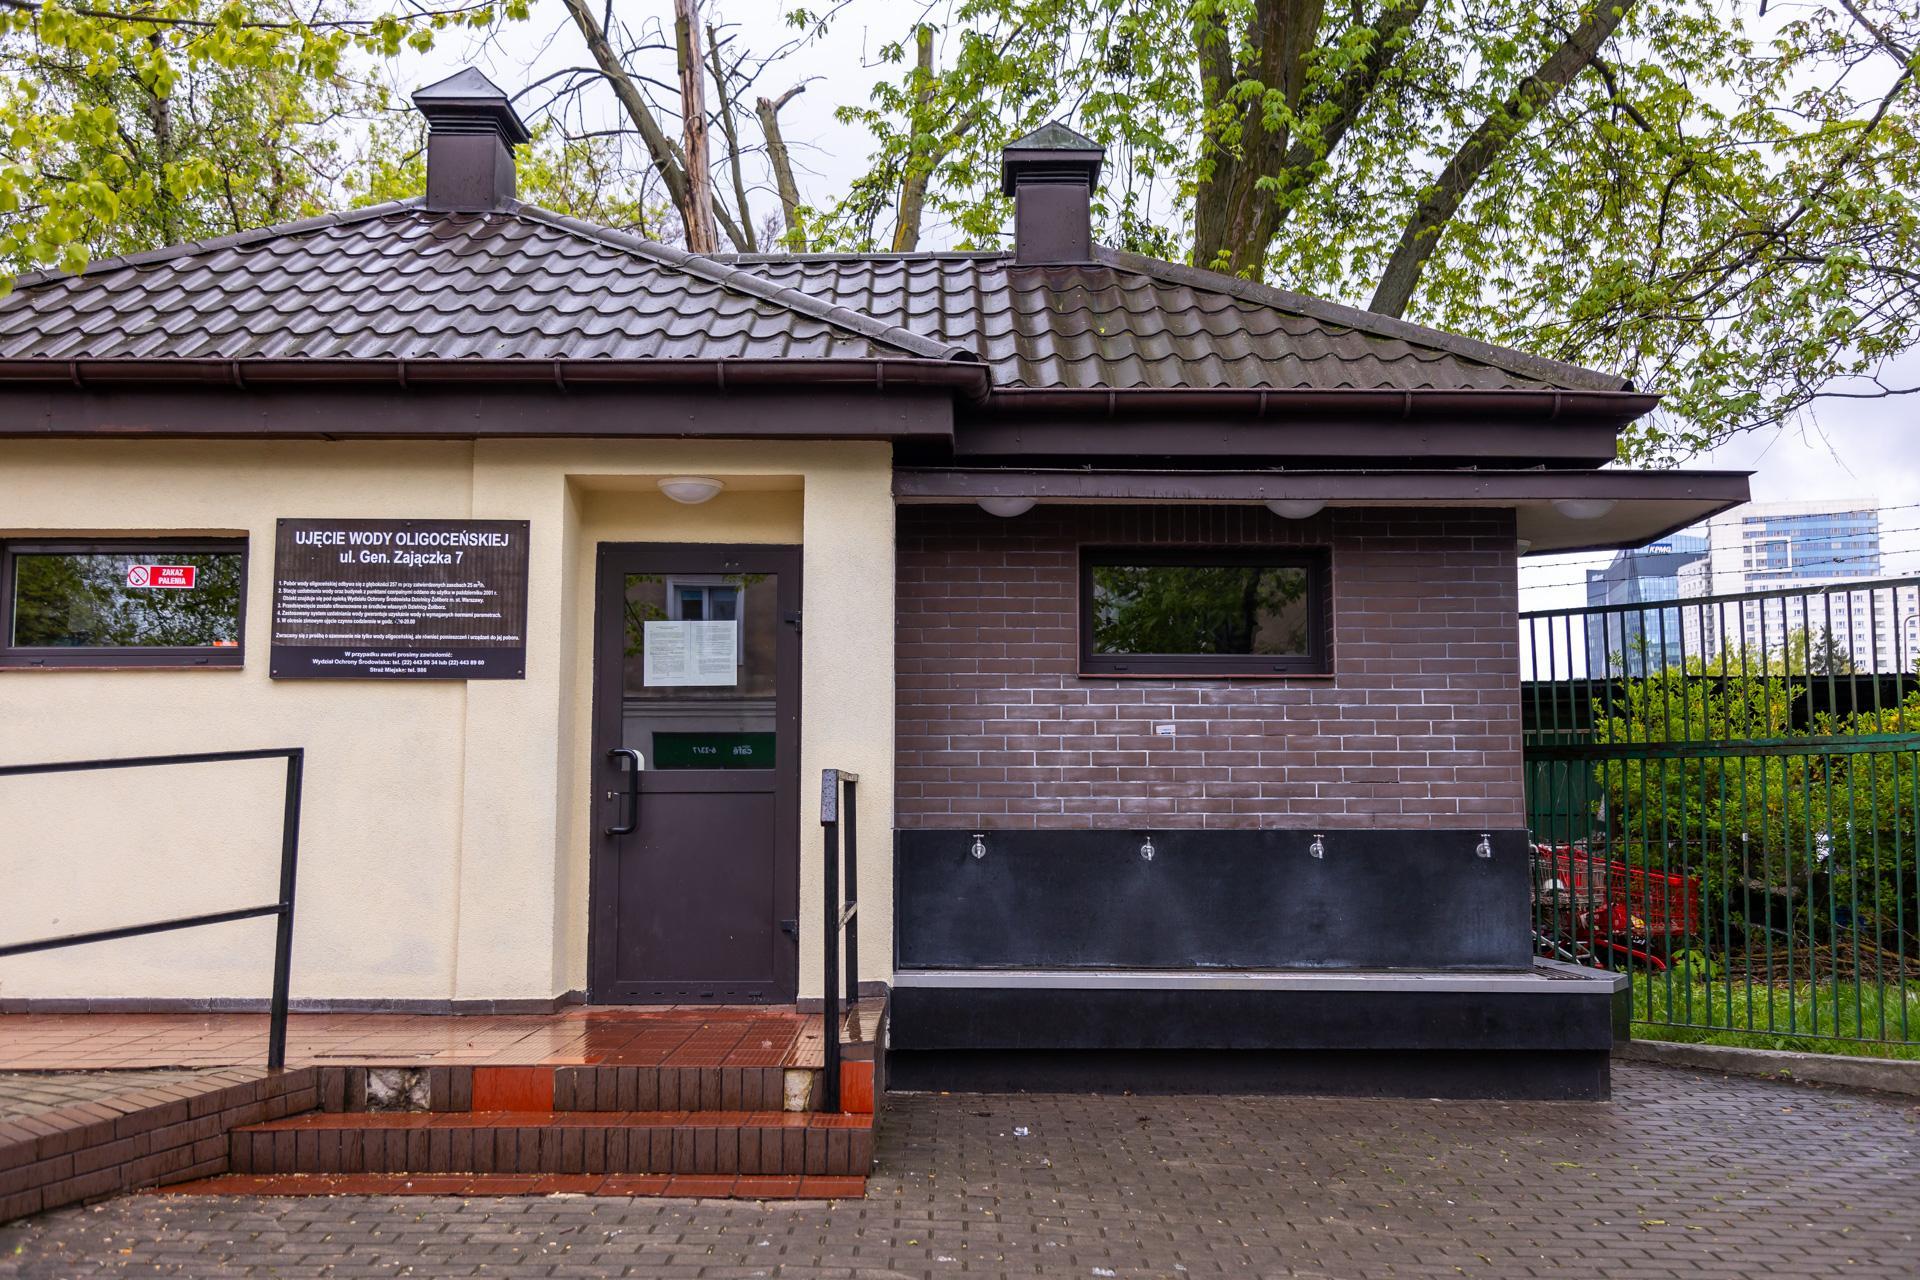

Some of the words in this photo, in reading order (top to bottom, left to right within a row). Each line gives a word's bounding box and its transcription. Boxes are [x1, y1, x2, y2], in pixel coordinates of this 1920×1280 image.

[295, 531, 346, 548] UJĘCIE
[349, 531, 393, 546] WODY
[395, 530, 509, 547] OLIGOCEŃSKIEJ
[1649, 545, 1672, 553] KPMG
[339, 550, 356, 564] ul.
[359, 550, 390, 564] Gen.
[393, 550, 452, 567] Zajączka
[455, 551, 464, 564] 7
[162, 568, 184, 576] ZAKAZ
[158, 577, 187, 585] PALENIA
